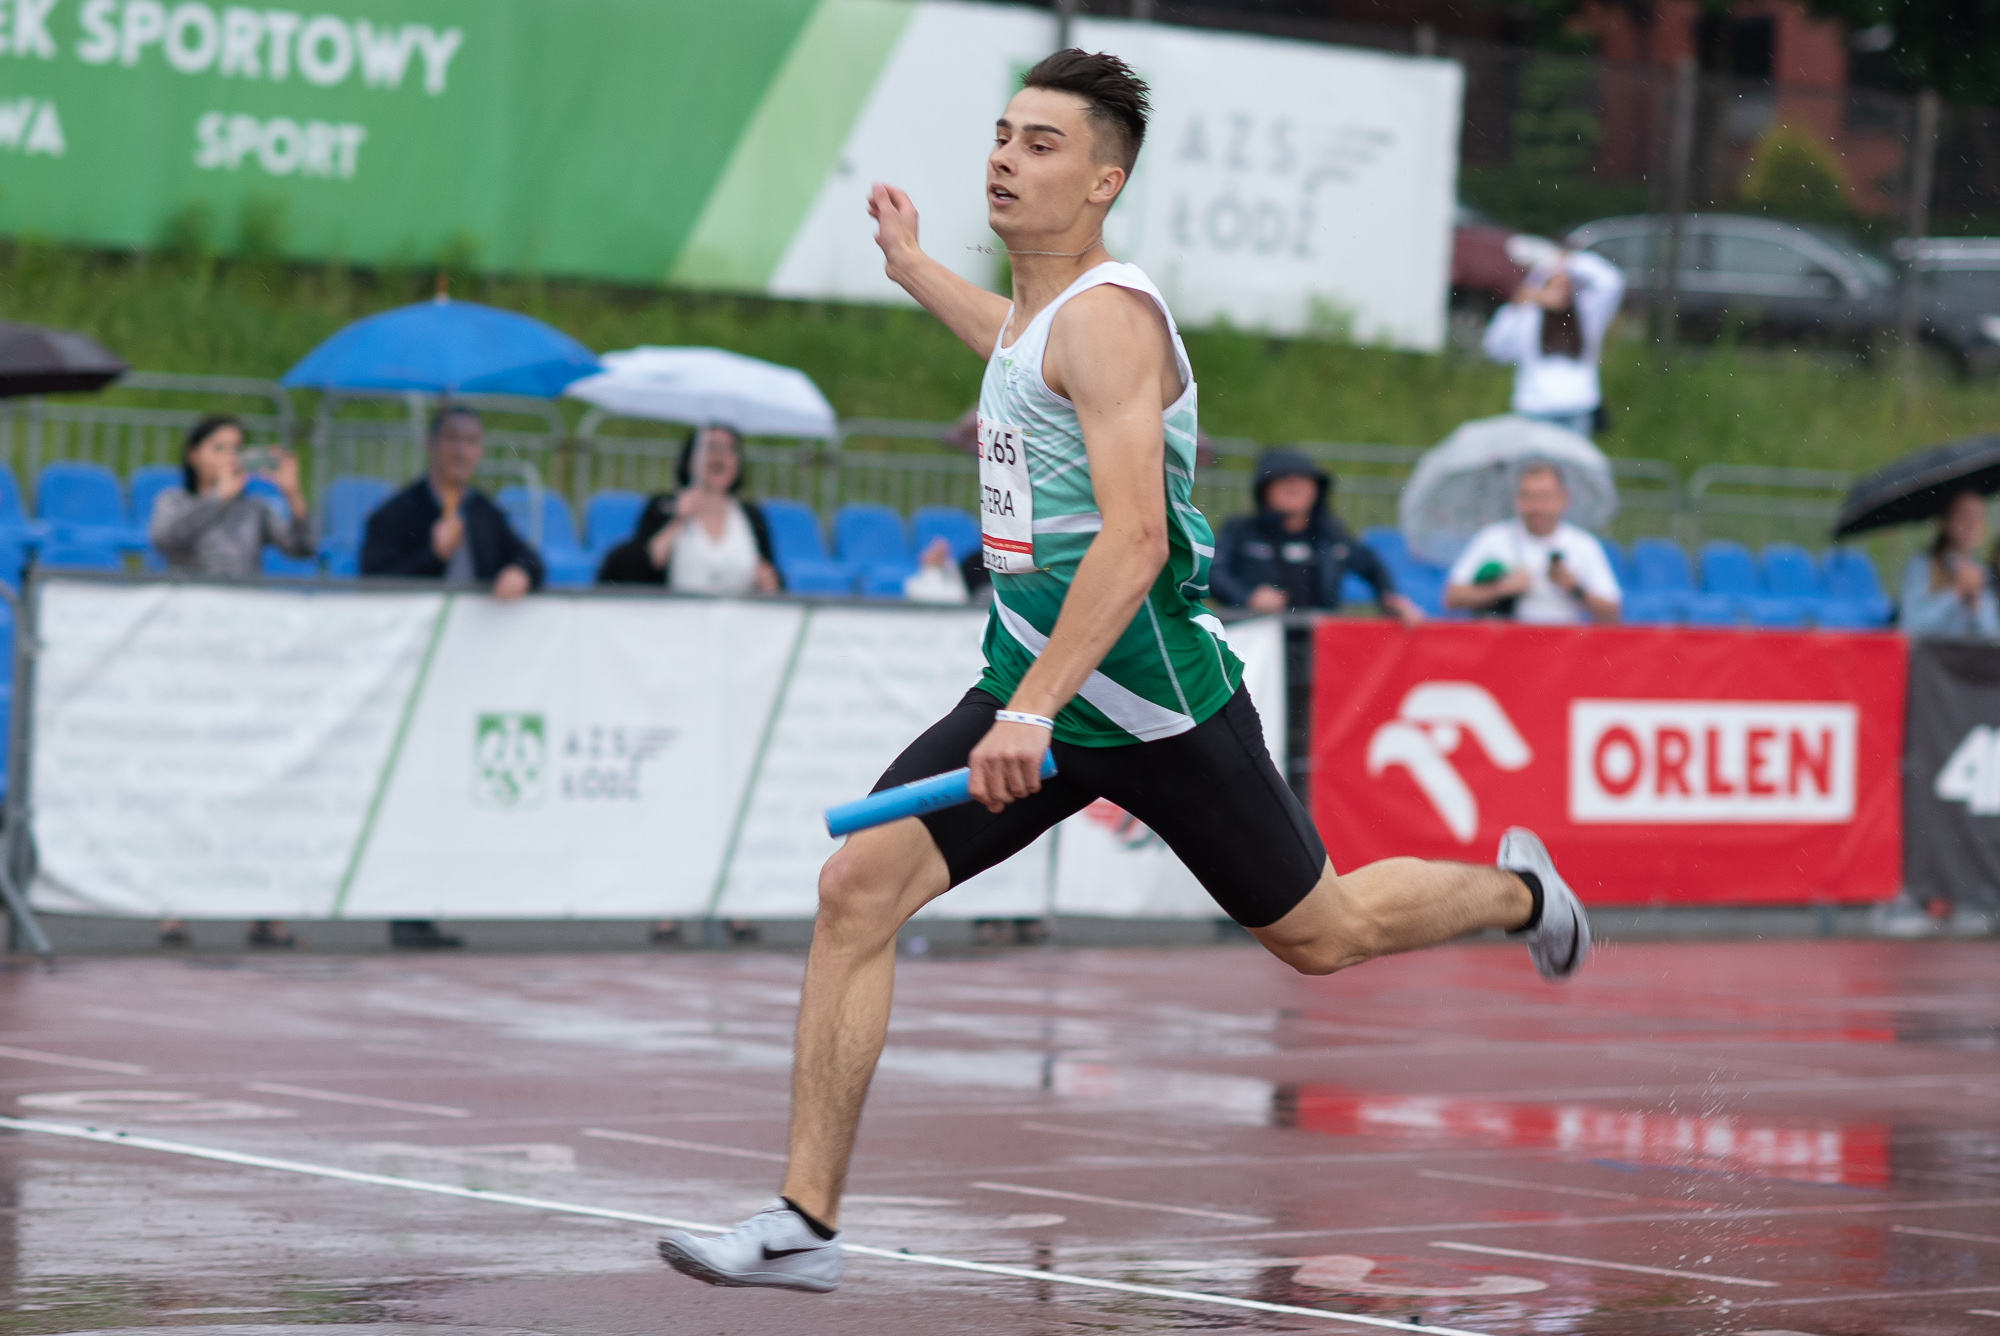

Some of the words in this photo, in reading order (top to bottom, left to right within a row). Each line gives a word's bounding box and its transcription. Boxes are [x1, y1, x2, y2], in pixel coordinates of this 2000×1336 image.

[77, 0, 463, 95] SPORTOWY
[194, 112, 366, 180] SPORT
[1176, 109, 1297, 175] AZS
[987, 428, 1016, 466] 265
[1593, 724, 1834, 798] ORLEN
